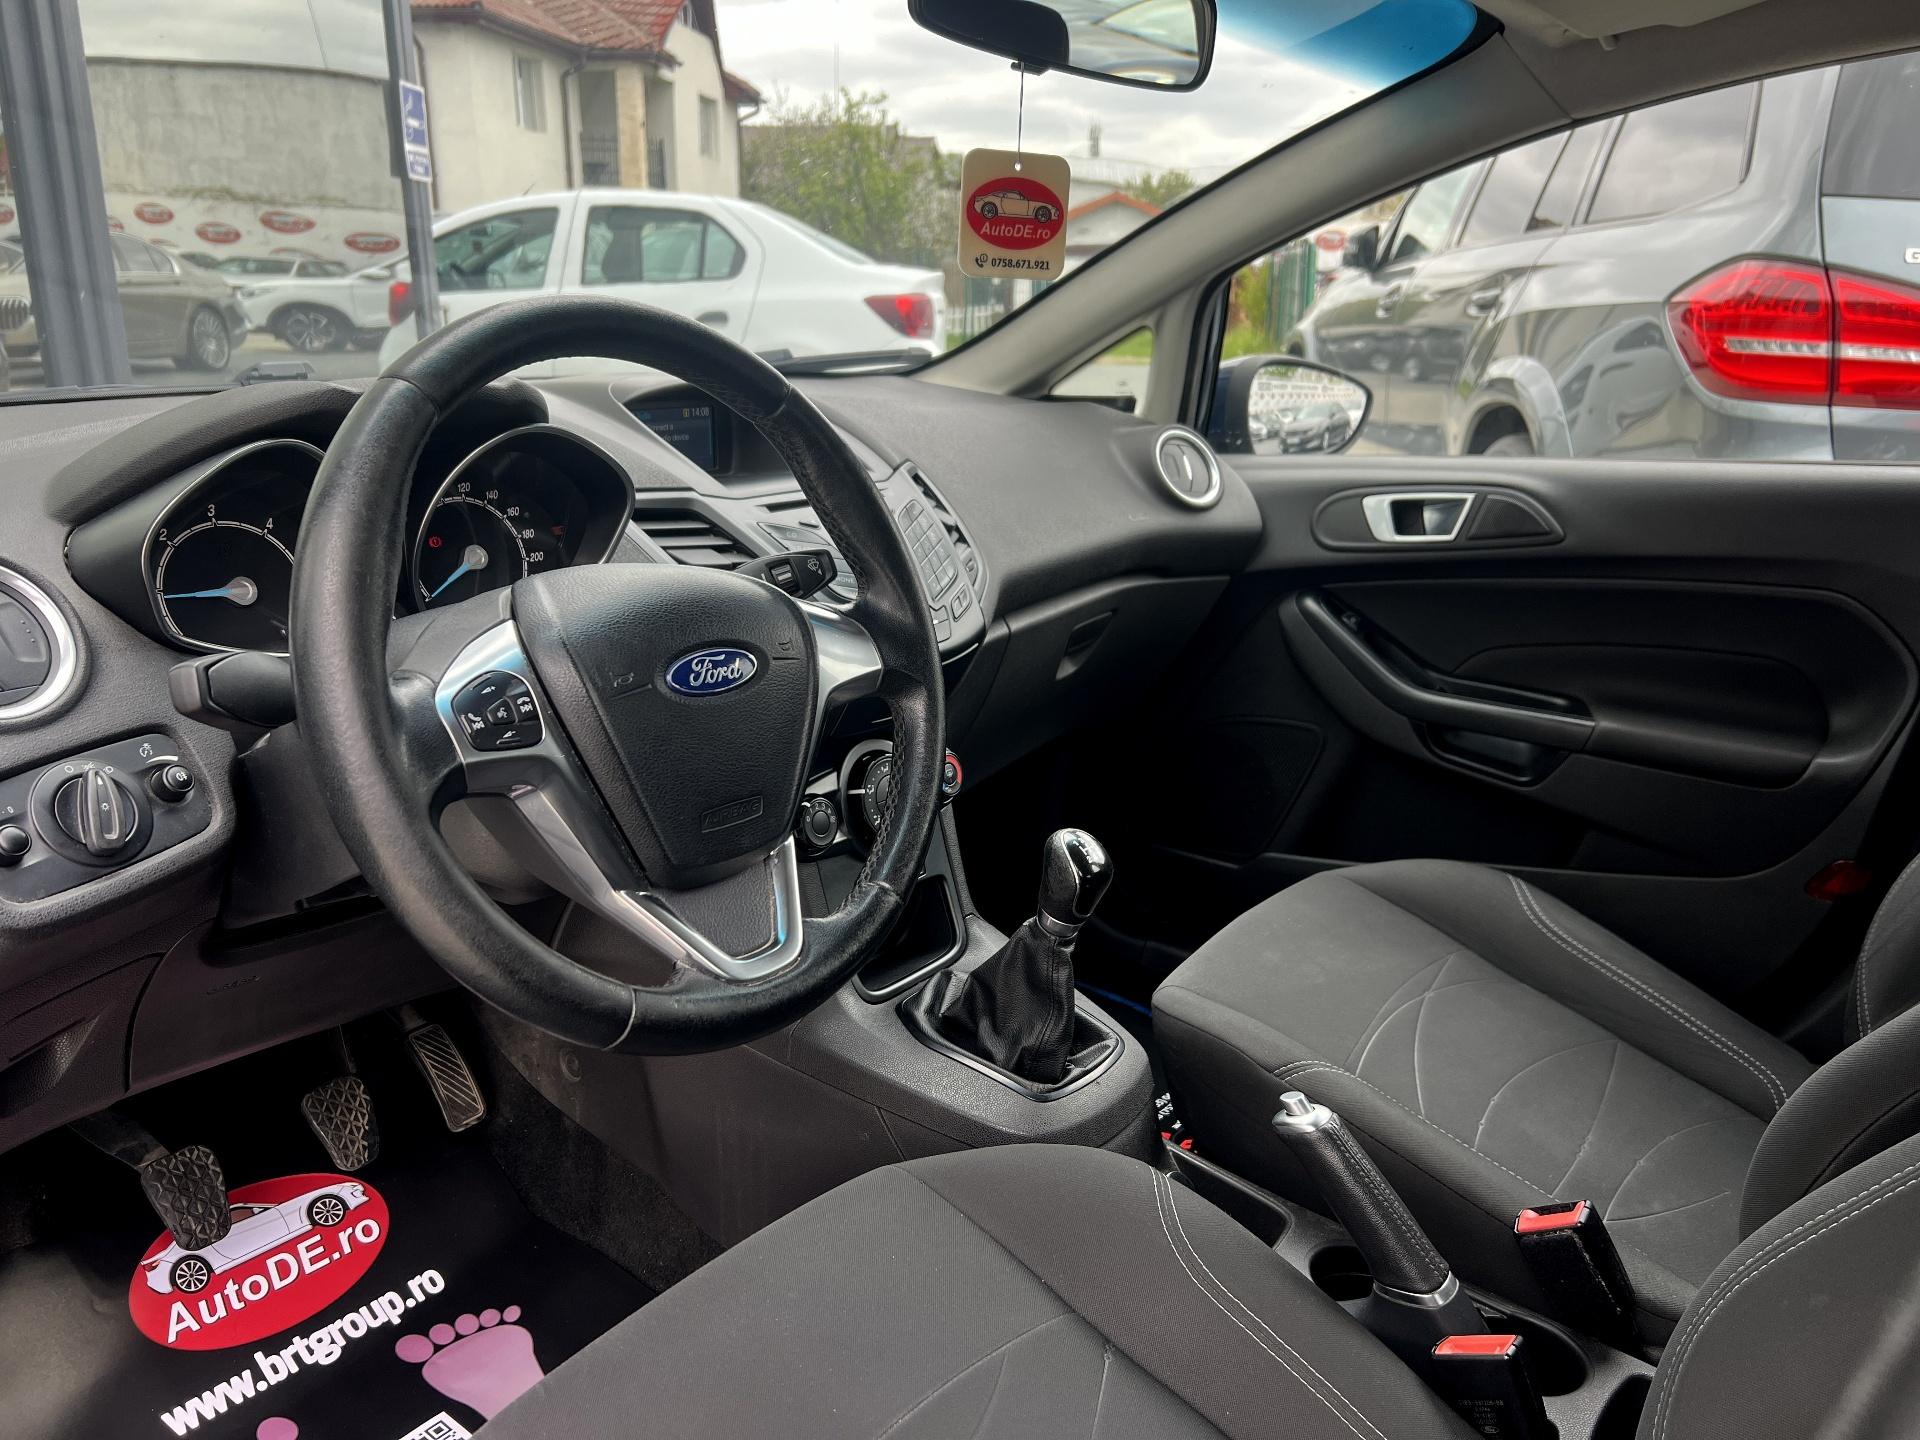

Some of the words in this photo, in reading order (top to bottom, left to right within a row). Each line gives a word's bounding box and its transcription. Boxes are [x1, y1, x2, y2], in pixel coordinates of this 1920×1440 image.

[980, 222, 1051, 240] AutoDE.ro
[991, 258, 1050, 271] 0758.671.921
[457, 482, 471, 493] 120
[485, 489, 499, 500] 140
[207, 504, 215, 517] 3
[507, 506, 520, 517] 160
[265, 517, 274, 530] 4
[159, 528, 168, 541] 2
[522, 529, 535, 539] 180
[530, 551, 544, 562] 200
[690, 654, 741, 687] Ford
[167, 1218, 381, 1343] AutoDE.ro
[160, 1268, 446, 1437] www.brtgroup.ro
